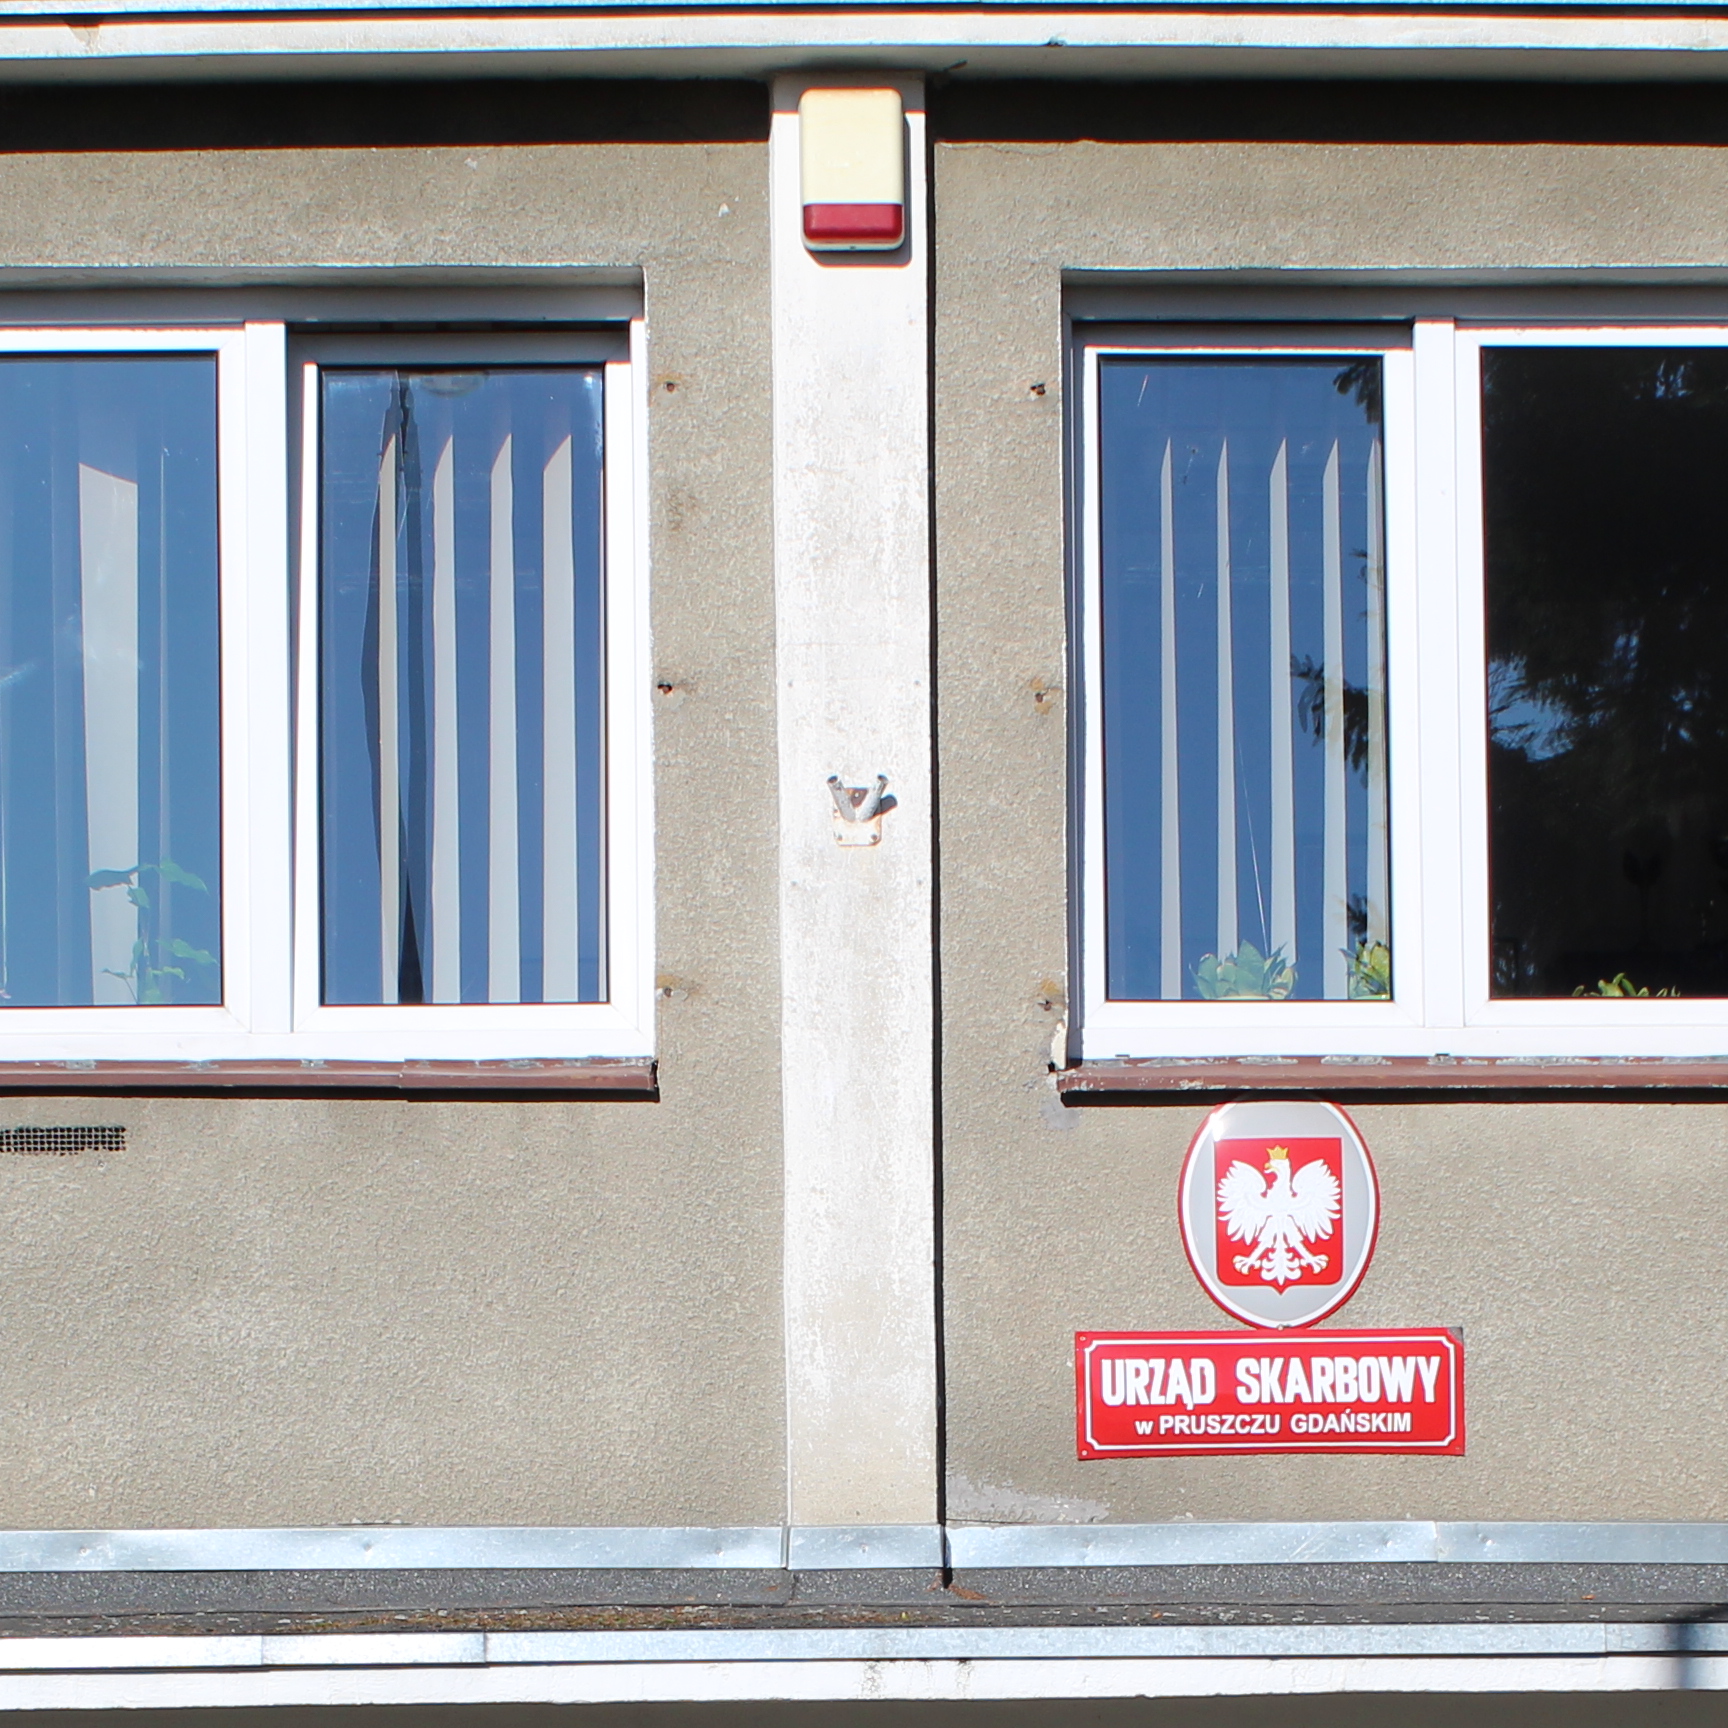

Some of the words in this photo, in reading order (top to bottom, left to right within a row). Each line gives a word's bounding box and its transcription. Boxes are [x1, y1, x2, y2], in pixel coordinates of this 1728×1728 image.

[1100, 1358, 1216, 1410] URZĄD
[1235, 1356, 1441, 1404] SKARBOWY
[1134, 1419, 1154, 1435] w
[1159, 1413, 1281, 1435] PRUSZCZU
[1289, 1408, 1412, 1433] GDAŃSKIM
